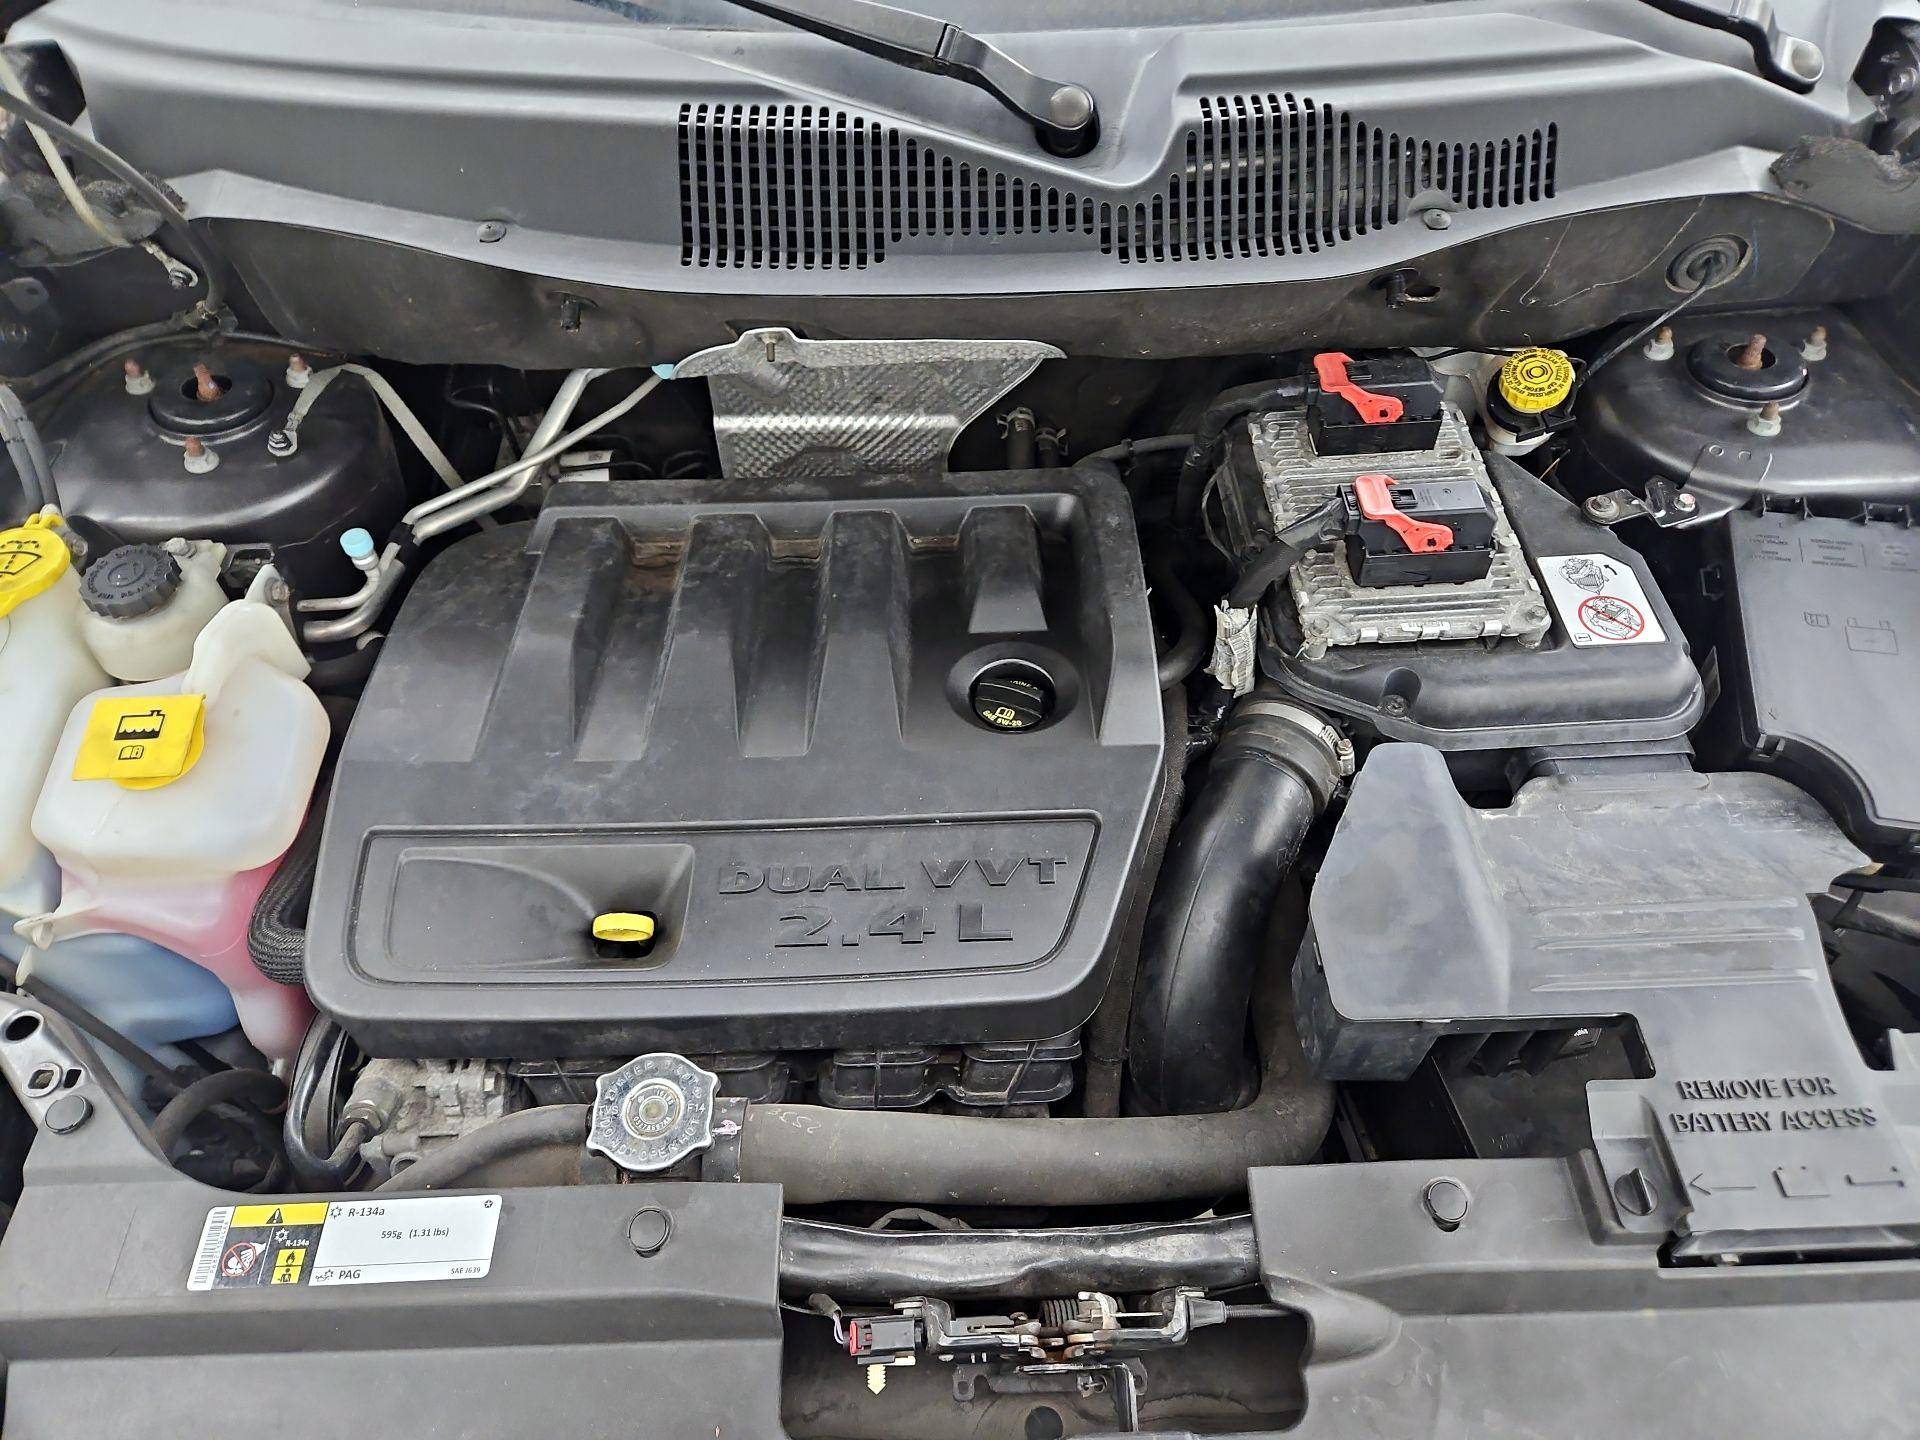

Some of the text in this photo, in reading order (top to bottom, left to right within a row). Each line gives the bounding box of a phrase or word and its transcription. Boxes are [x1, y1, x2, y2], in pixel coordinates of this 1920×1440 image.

[719, 857, 1068, 894] DUAL VVT
[1676, 1076, 1838, 1101] REMOVE FOR
[599, 1104, 619, 1115] TVS
[687, 1101, 707, 1113] F14
[1669, 1107, 1879, 1134] BATTERY ACCESS
[600, 1118, 616, 1138] DO
[348, 1207, 386, 1218] R-134a
[380, 1226, 450, 1240] 595g (1.31 lbs)
[285, 1238, 310, 1248] R-134a
[338, 1268, 362, 1280] PAG
[450, 1267, 464, 1275] SAE
